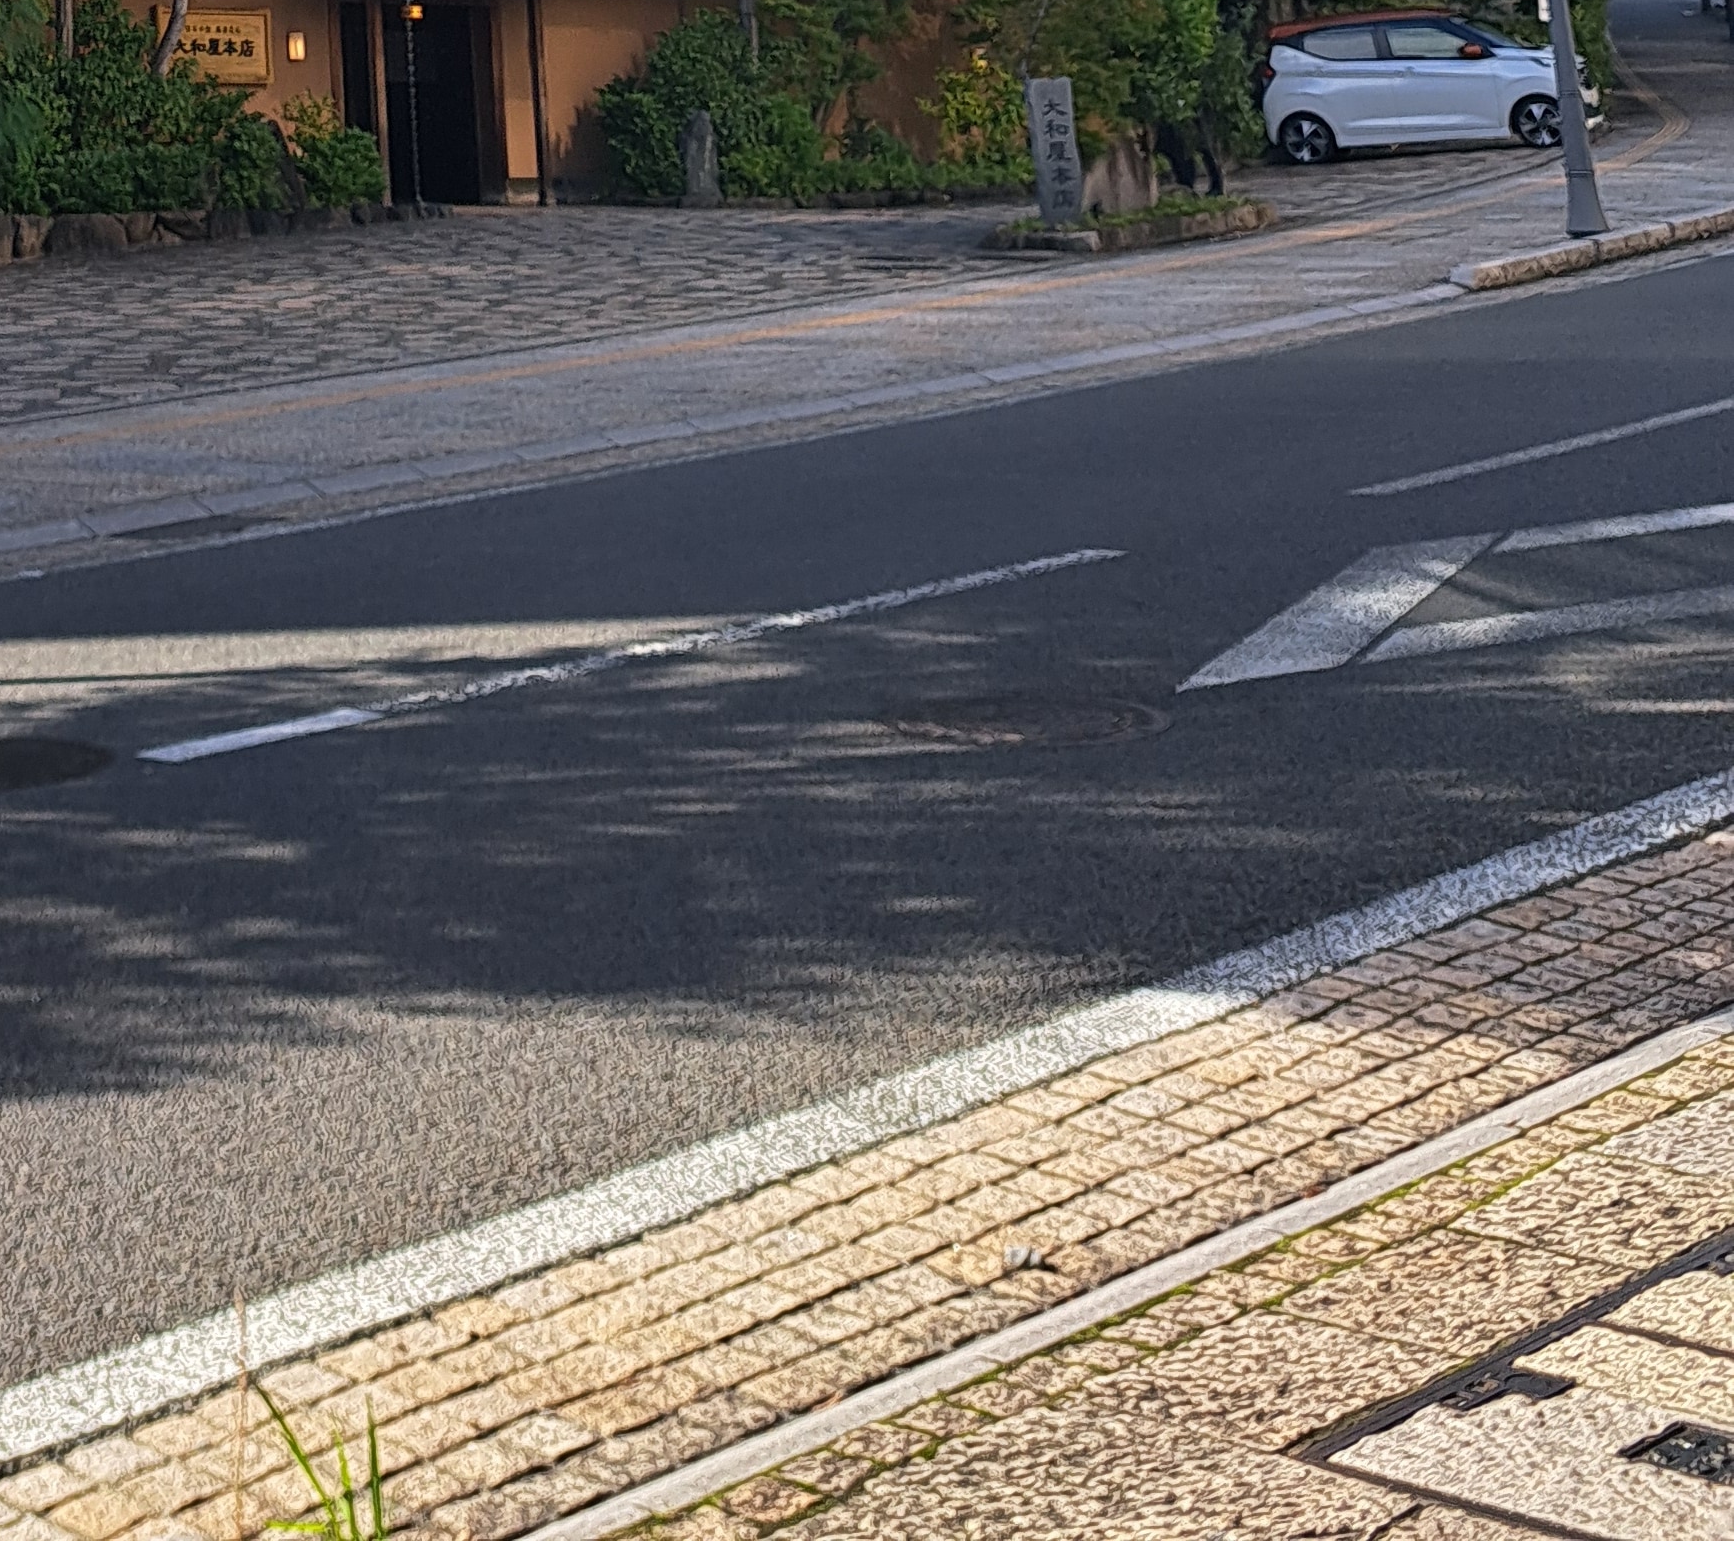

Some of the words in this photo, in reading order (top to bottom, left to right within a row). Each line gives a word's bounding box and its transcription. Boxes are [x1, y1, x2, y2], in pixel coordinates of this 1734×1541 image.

[172, 38, 255, 57] 大和屋本店
[1042, 99, 1077, 210] 大和屋本店
